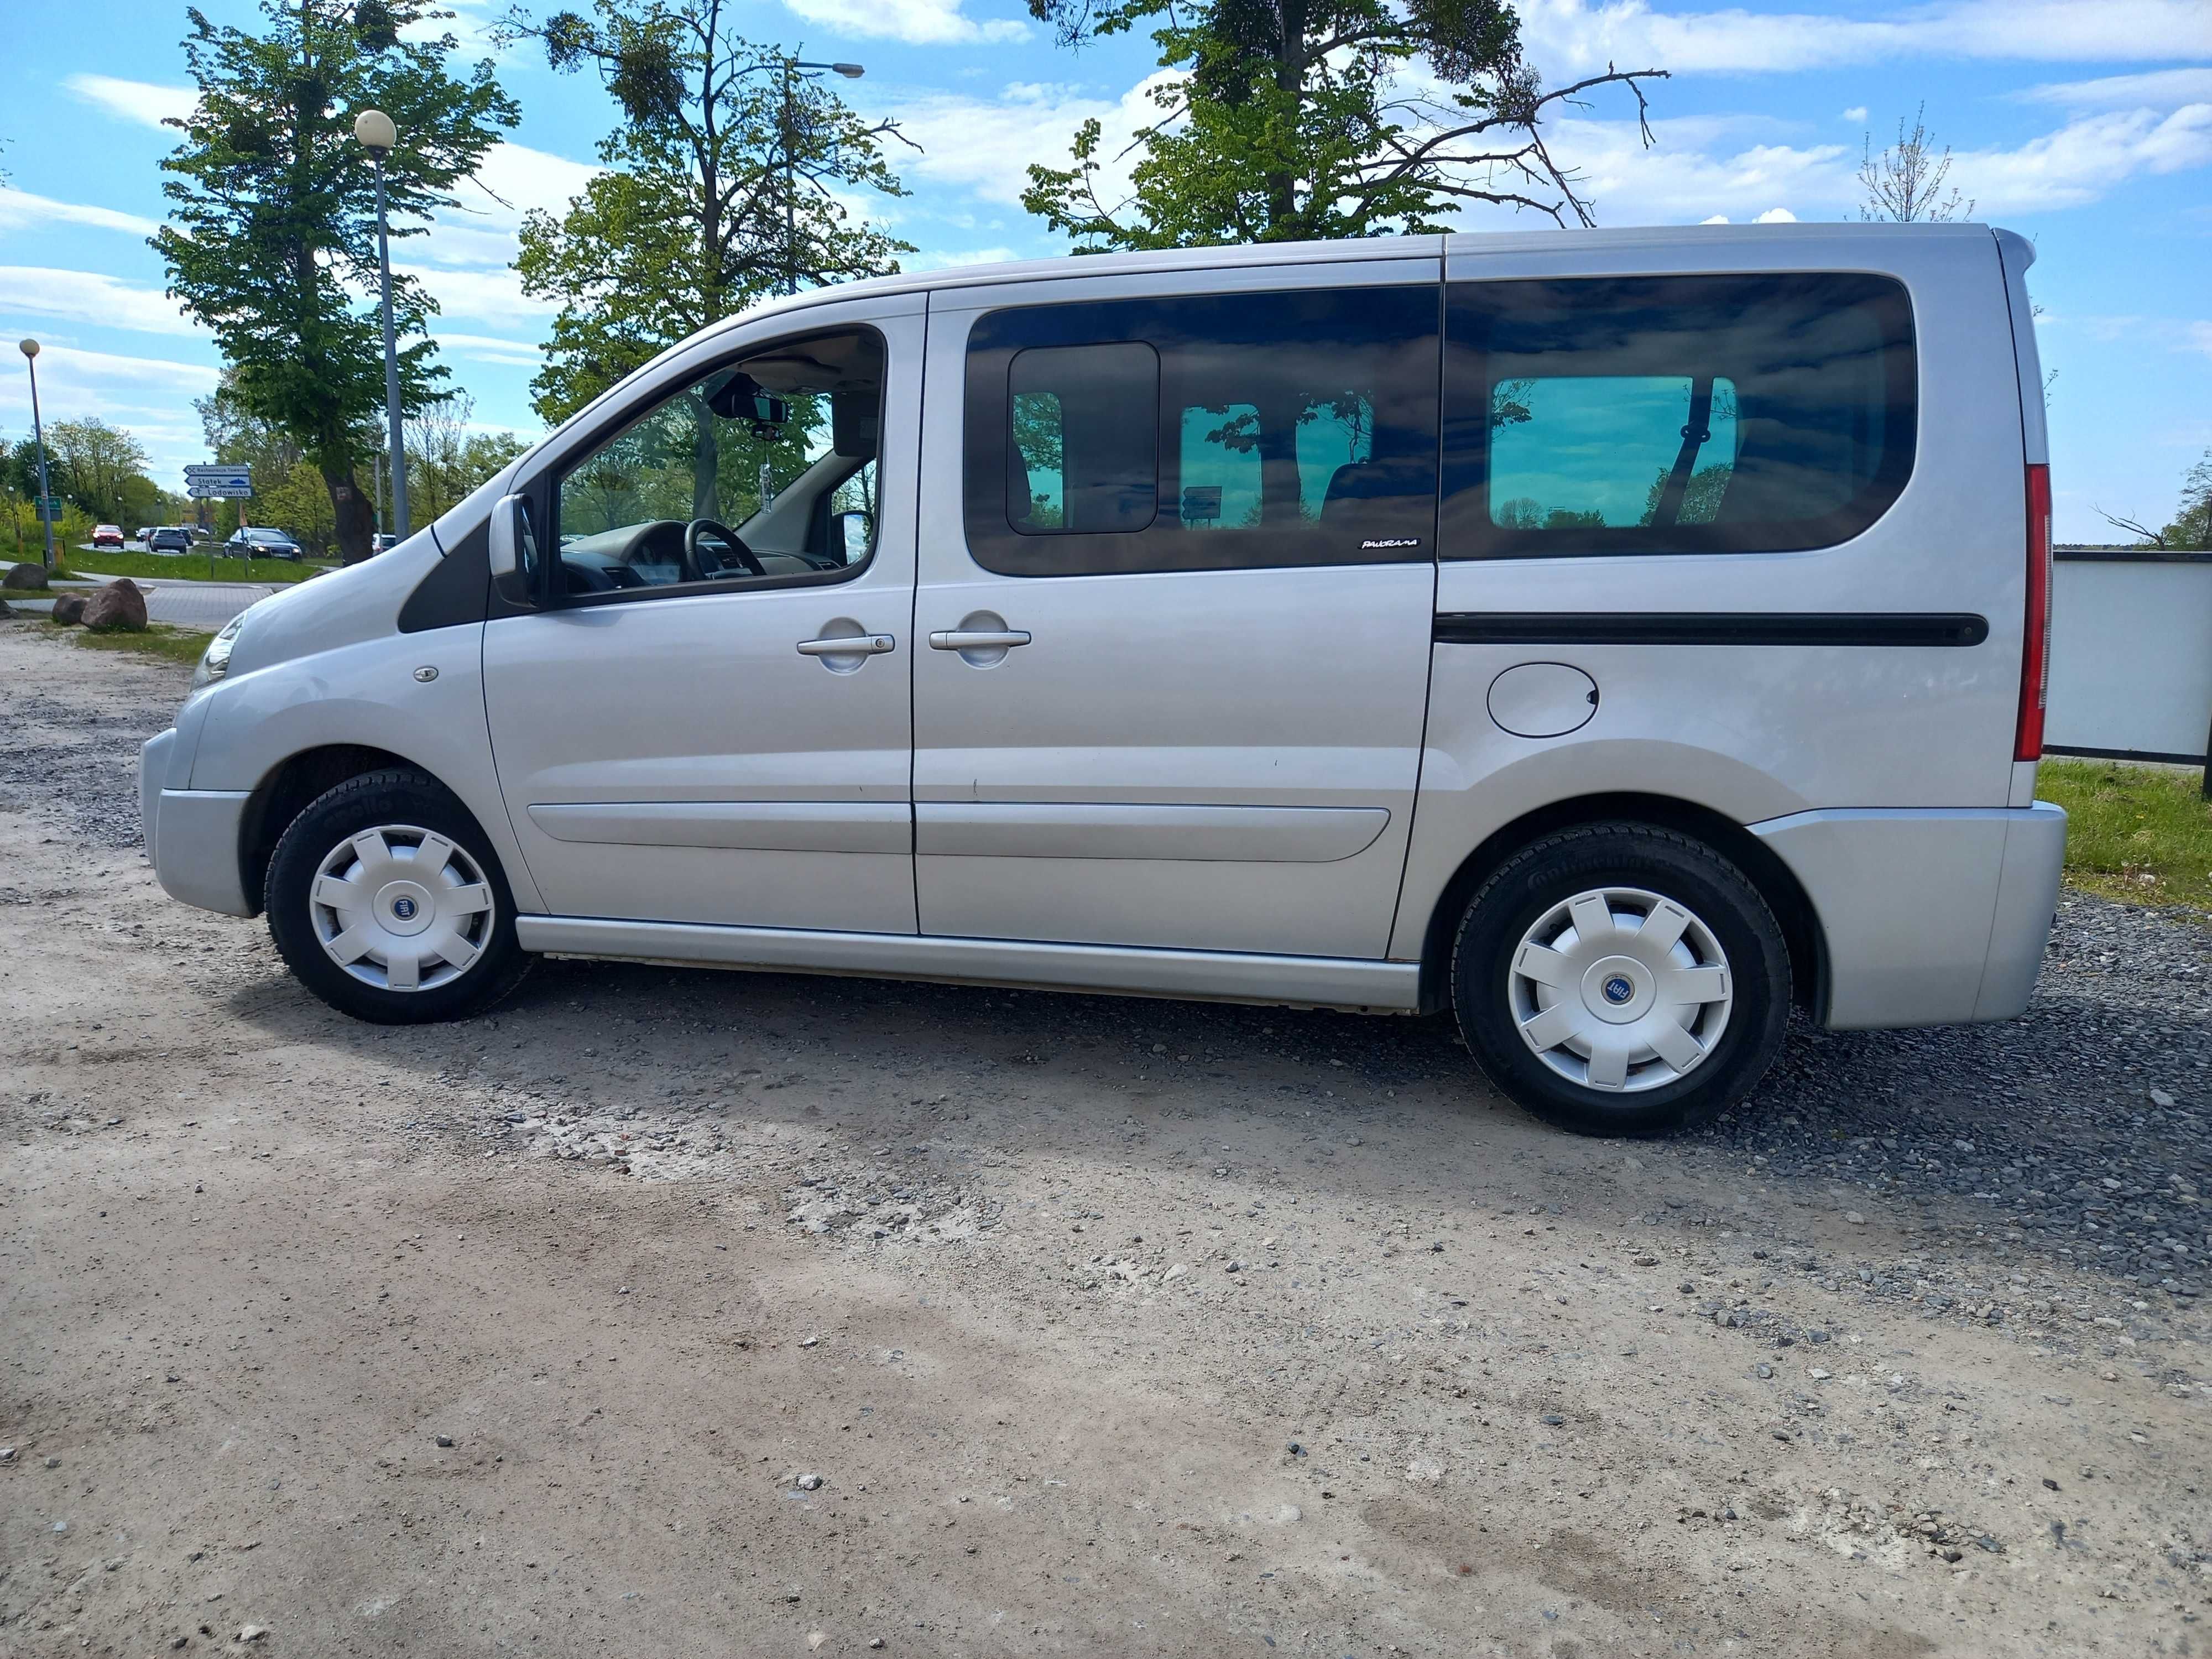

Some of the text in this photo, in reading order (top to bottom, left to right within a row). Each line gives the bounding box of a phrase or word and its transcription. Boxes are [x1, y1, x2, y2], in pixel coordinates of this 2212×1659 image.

[1361, 539, 1417, 549] PANORAMA
[399, 900, 410, 916] FIAT
[1607, 982, 1629, 999] FIAT
